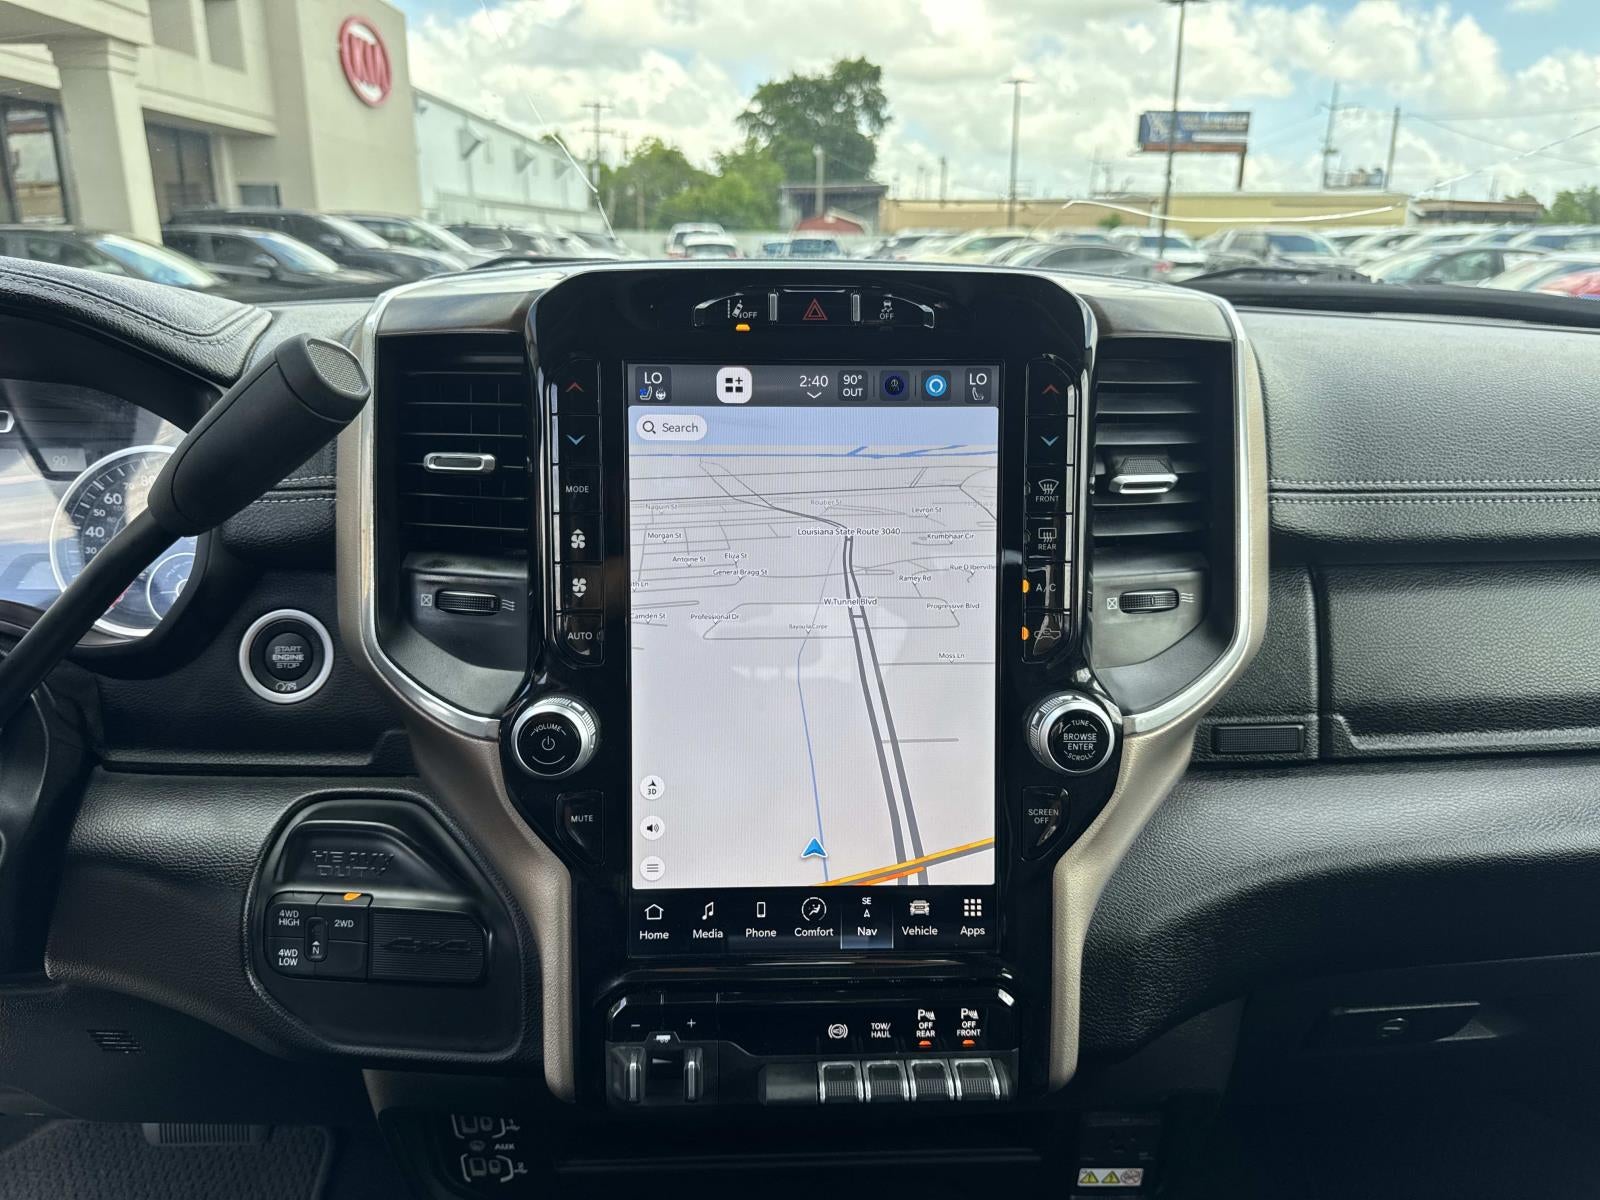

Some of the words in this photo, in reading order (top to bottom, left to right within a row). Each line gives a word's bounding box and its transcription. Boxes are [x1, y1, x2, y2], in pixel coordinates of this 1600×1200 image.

[742, 310, 758, 319] OFF
[880, 311, 894, 320] OFF
[644, 371, 663, 385] LO
[799, 374, 829, 388] 2:40
[843, 374, 863, 386] 90°
[969, 372, 988, 386] LO
[842, 387, 864, 397] OUT
[661, 422, 699, 434] Search
[565, 485, 590, 494] MODE
[103, 492, 123, 505] 60
[1035, 495, 1060, 503] FRONT
[93, 508, 106, 517] 50
[85, 526, 105, 538] 40
[797, 526, 834, 537] Louisiana
[835, 526, 855, 537] State
[856, 527, 879, 537] Route
[880, 526, 901, 537] 3040
[647, 532, 673, 541] Morgan
[674, 532, 682, 540] St
[85, 546, 98, 555] 30
[1037, 543, 1057, 551] REAR
[713, 569, 739, 577] General
[740, 569, 760, 579] Bragg
[760, 569, 768, 577] St
[924, 573, 932, 582] Rd
[1035, 583, 1057, 592] A/C
[834, 597, 859, 606] Tunnel
[860, 597, 878, 606] Blvd
[690, 612, 730, 621] Professional
[732, 612, 740, 620] Dr
[567, 631, 593, 641] AUTO
[938, 652, 957, 660] Moss
[958, 652, 966, 660] Ln
[1071, 719, 1090, 727] TUNE
[533, 723, 562, 733] VOLUME
[1063, 732, 1097, 741] BROWSE
[1067, 742, 1094, 751] ENTER
[1067, 751, 1094, 761] SCROLL
[647, 787, 657, 796] 3D
[1028, 807, 1059, 817] SCREEN
[570, 814, 594, 823] MUTE
[1033, 816, 1050, 825] OFF
[861, 897, 872, 905] SE
[279, 909, 299, 918] 4WD
[278, 917, 300, 927] HIGH
[334, 919, 354, 929] 2WD
[639, 929, 670, 940] Home
[692, 928, 724, 939] Media
[745, 927, 777, 938] Phone
[794, 927, 834, 938] Comfort
[857, 926, 878, 937] Nav
[901, 925, 938, 936] Vehicle
[960, 925, 986, 938] Apps
[278, 948, 298, 958] 4WD
[312, 946, 320, 955] N
[278, 957, 298, 967] LOW
[871, 1022, 891, 1030] TOW/
[918, 1021, 934, 1030] OFF
[961, 1020, 977, 1029] OFF
[871, 1030, 891, 1038] HAUL
[916, 1029, 935, 1038] REAR
[956, 1029, 981, 1037] FRONT
